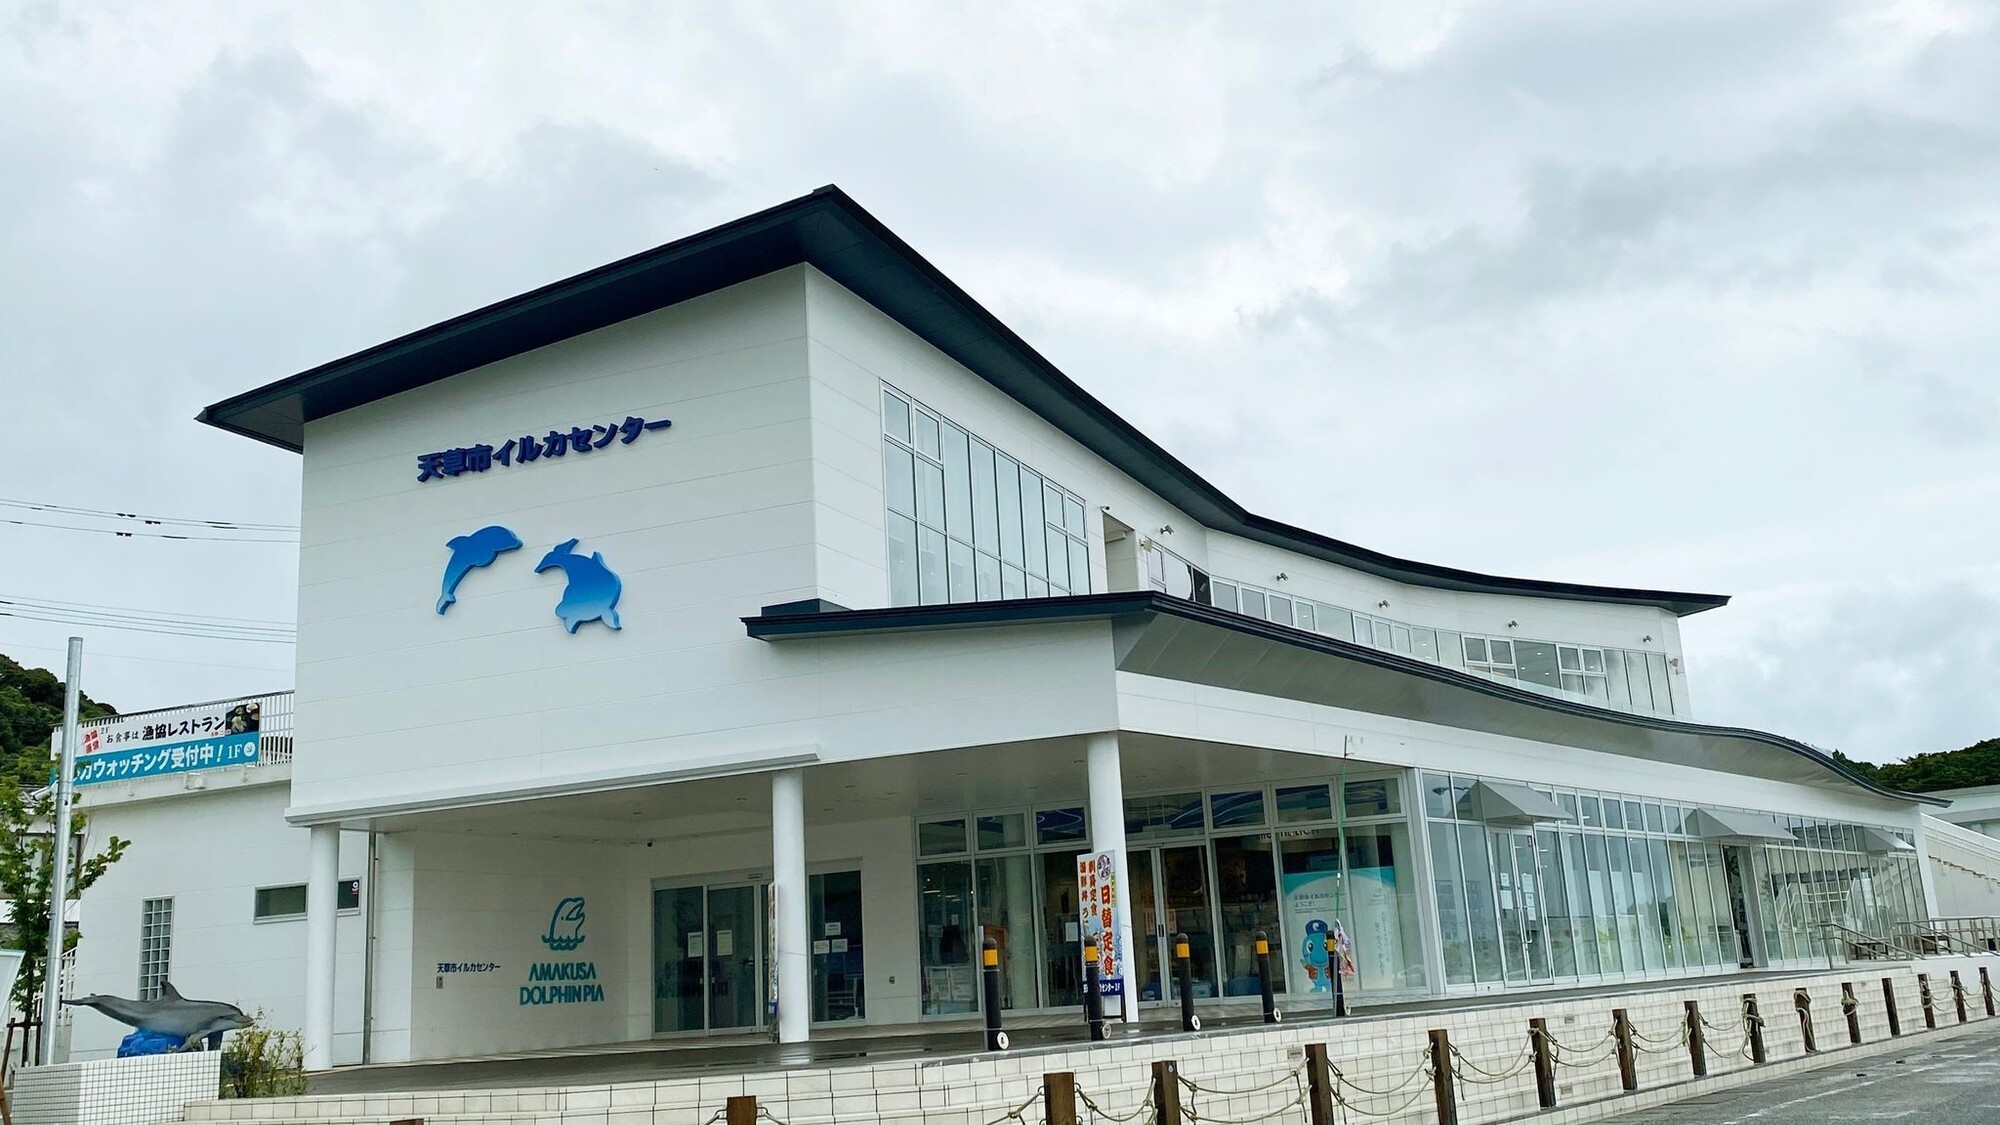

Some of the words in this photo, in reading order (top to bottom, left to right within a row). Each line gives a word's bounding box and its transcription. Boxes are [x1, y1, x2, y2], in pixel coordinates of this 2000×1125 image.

[417, 416, 672, 482] 天草市イルカセンター
[106, 731, 139, 744] お食事は
[142, 716, 225, 741] 漁協レストラン
[227, 744, 242, 760] 1F
[1101, 884, 1114, 976] 日替定食
[437, 962, 500, 974] 天草市イルカセンター
[529, 962, 596, 981] AMAKUSA
